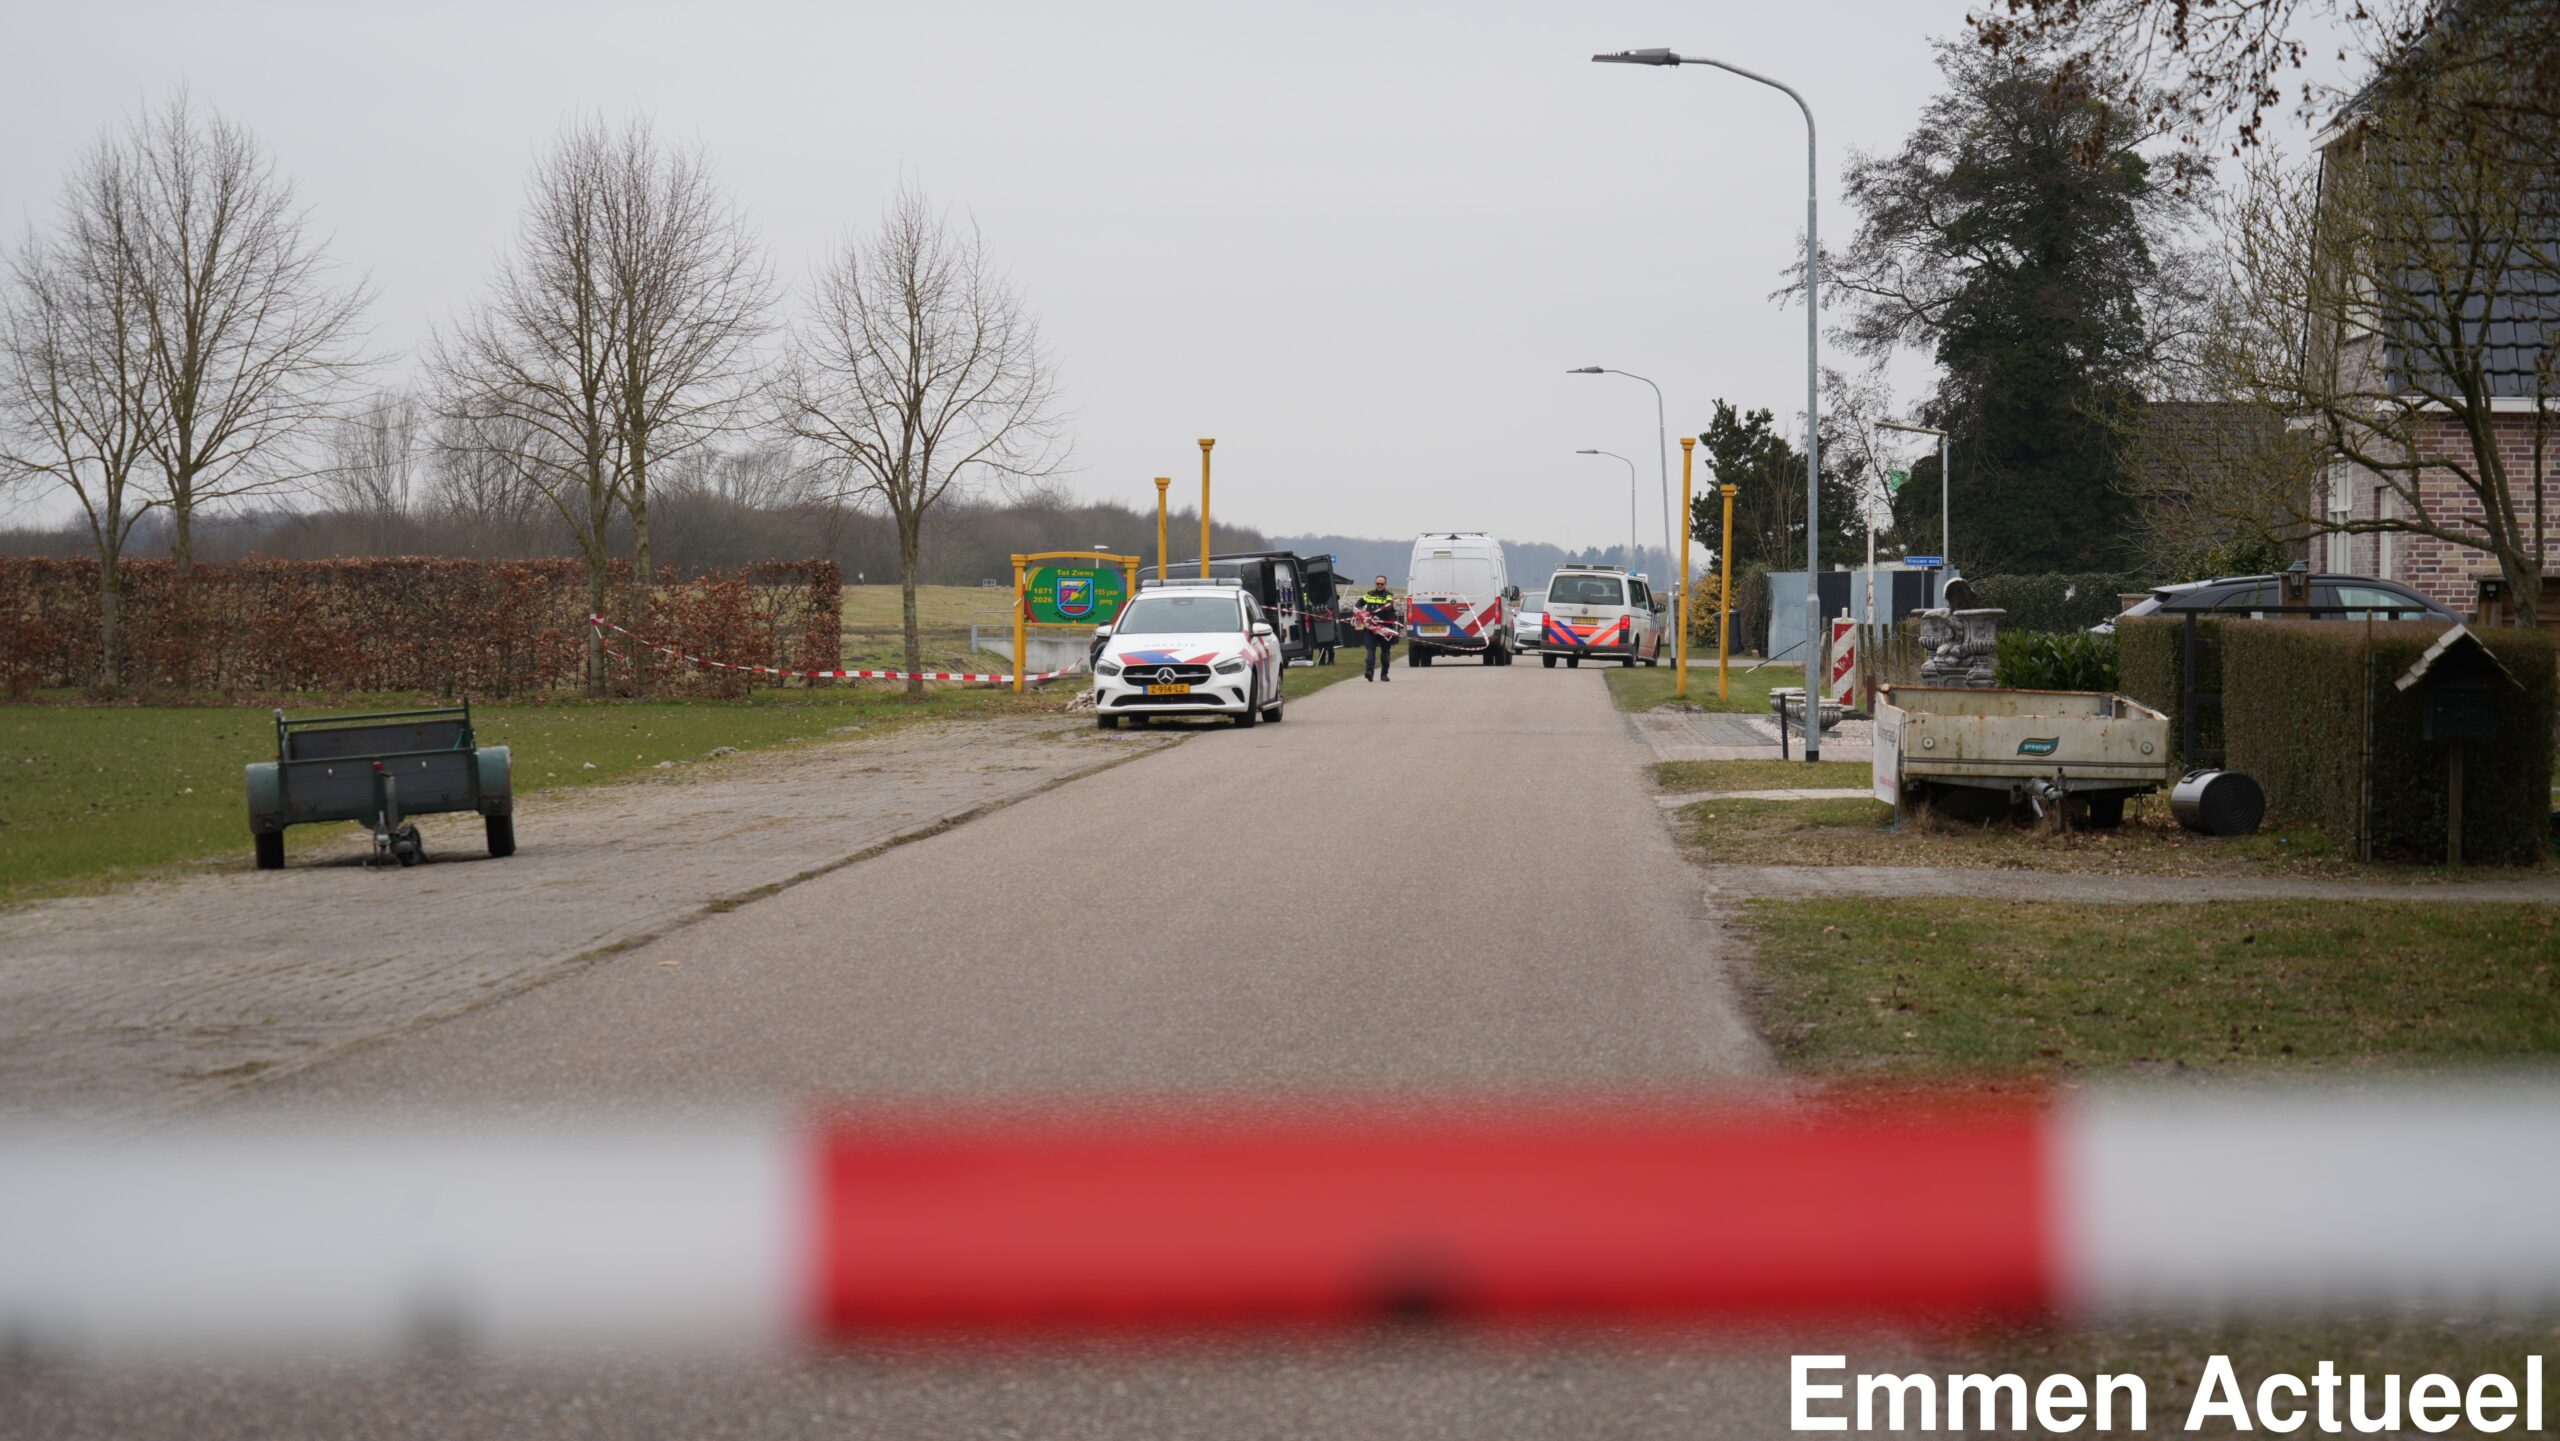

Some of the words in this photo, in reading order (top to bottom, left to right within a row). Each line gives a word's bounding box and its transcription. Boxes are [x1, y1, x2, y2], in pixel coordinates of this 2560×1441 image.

[1057, 569, 1070, 577] Tot
[1072, 569, 1095, 577] Ziens
[1033, 587, 1053, 595] 1871
[1033, 596, 1053, 604] 2026
